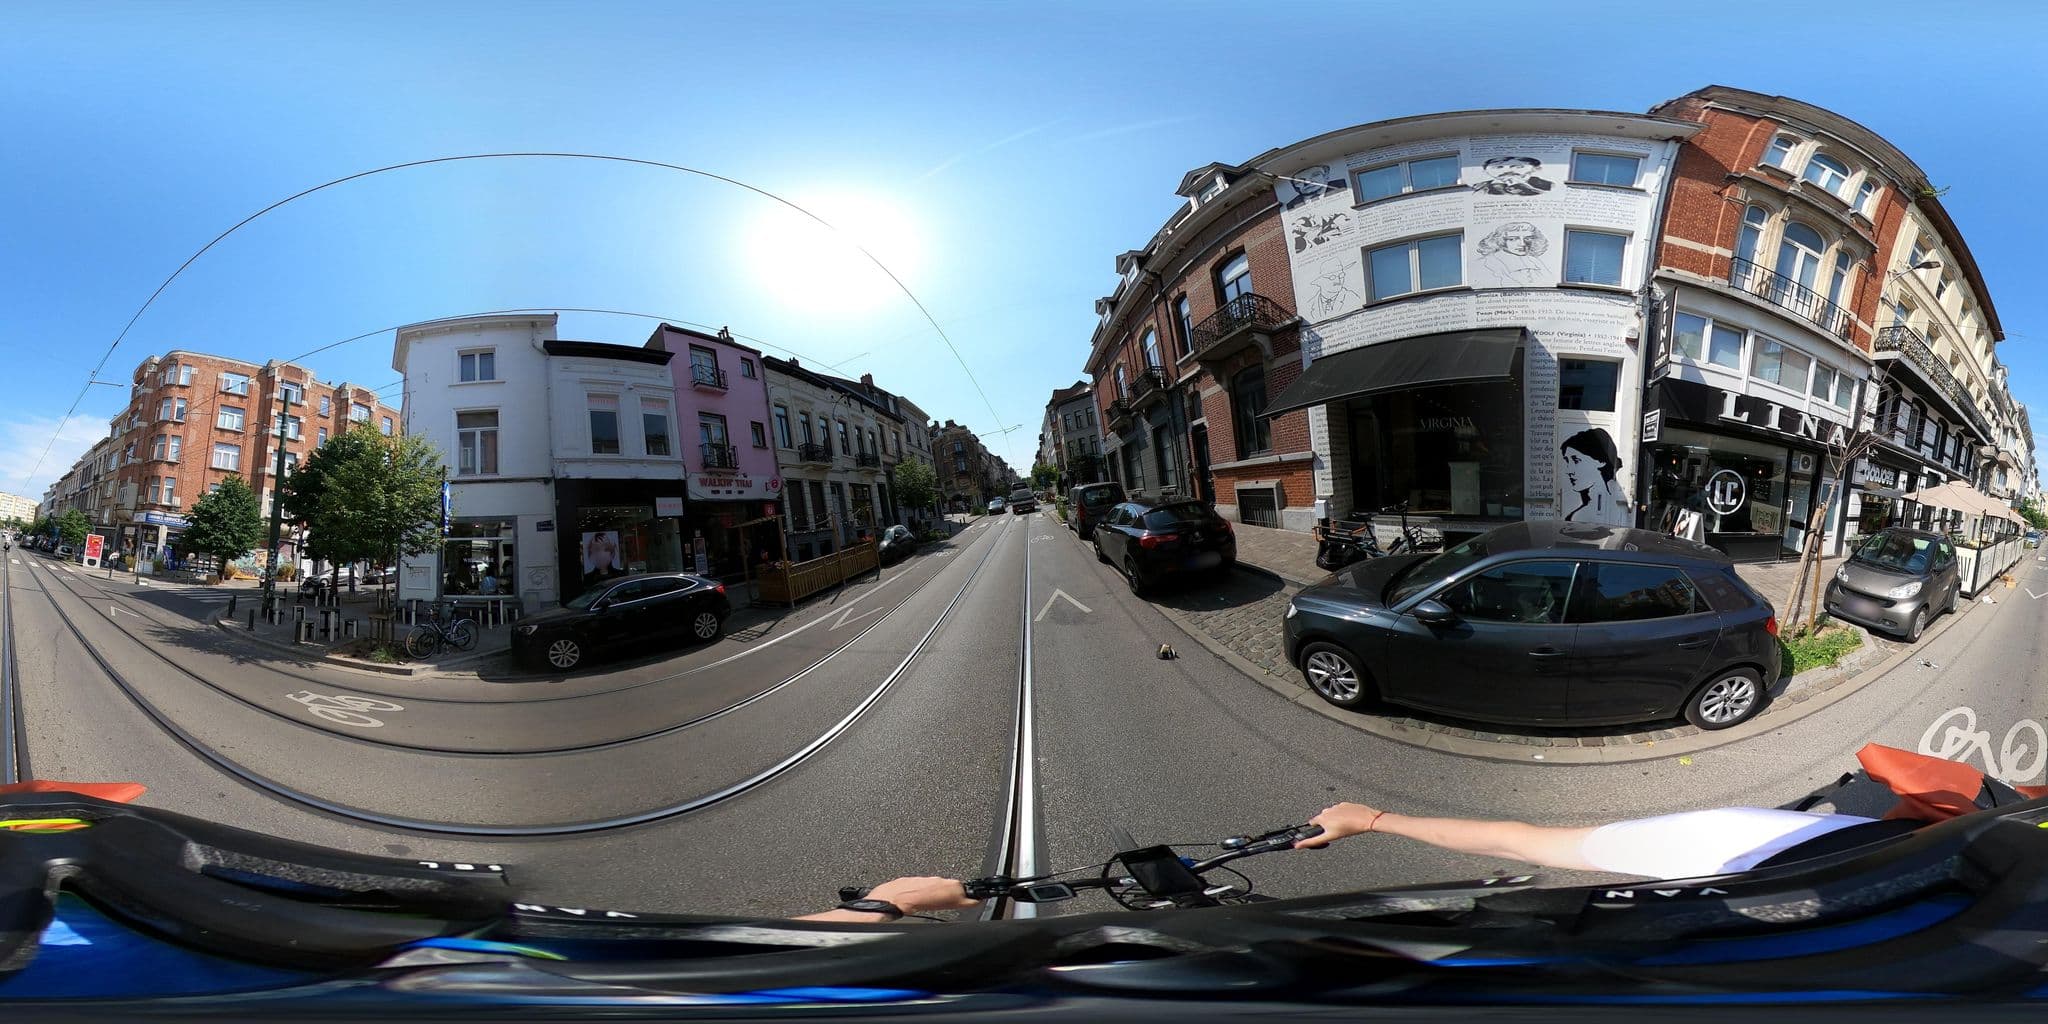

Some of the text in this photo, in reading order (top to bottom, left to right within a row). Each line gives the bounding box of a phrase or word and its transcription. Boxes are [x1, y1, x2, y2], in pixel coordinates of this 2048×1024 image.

[1557, 330, 1586, 339] (Virginia)
[1658, 300, 1669, 357] LINA
[1420, 416, 1473, 429] VIRGINIA
[1718, 390, 1847, 448] LINA
[1713, 480, 1739, 506] LC
